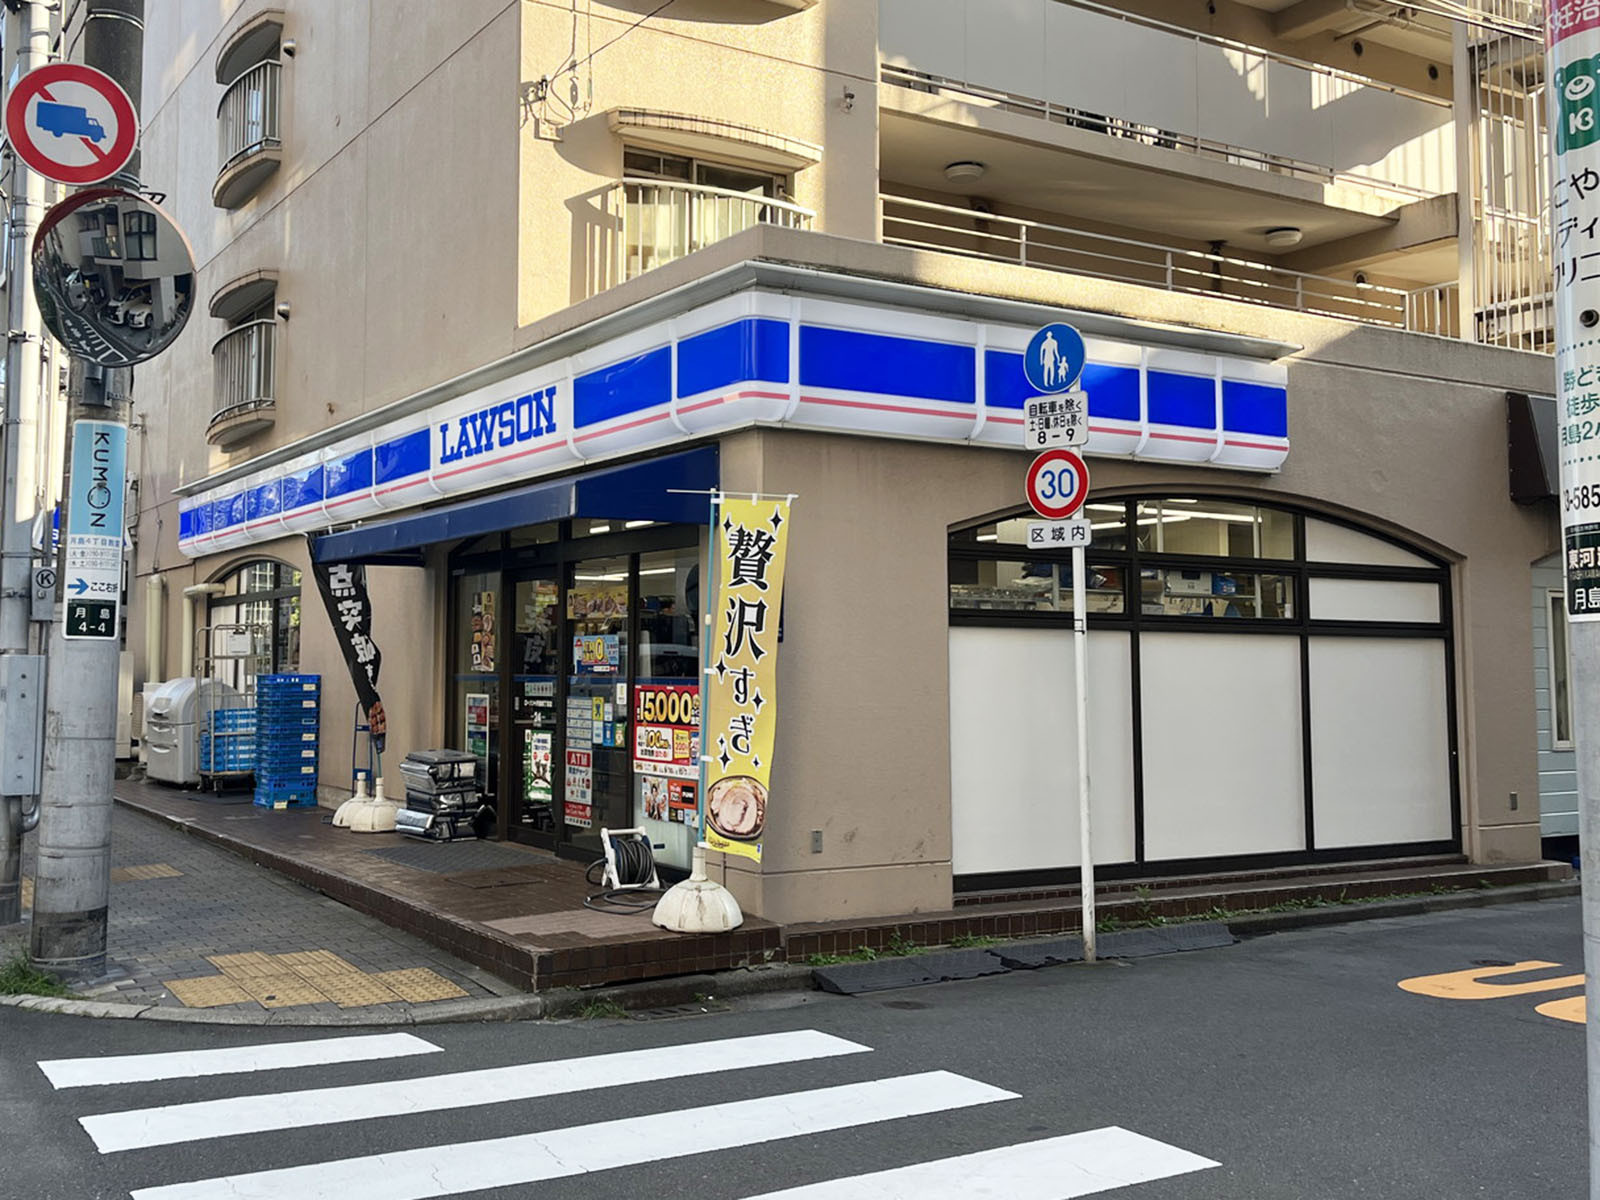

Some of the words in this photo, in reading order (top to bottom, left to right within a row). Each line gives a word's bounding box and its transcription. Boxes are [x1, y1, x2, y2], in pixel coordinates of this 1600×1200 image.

[1029, 398, 1082, 417] 自転車を除く
[440, 385, 557, 464] LAWSON
[88, 431, 111, 528] KUMON
[1041, 468, 1074, 499] 30
[1031, 526, 1085, 543] 区域内
[1575, 586, 1600, 610] 月島
[74, 606, 110, 620] 月島
[79, 621, 106, 634] 4-4
[724, 524, 776, 755] 贅沢すぎ
